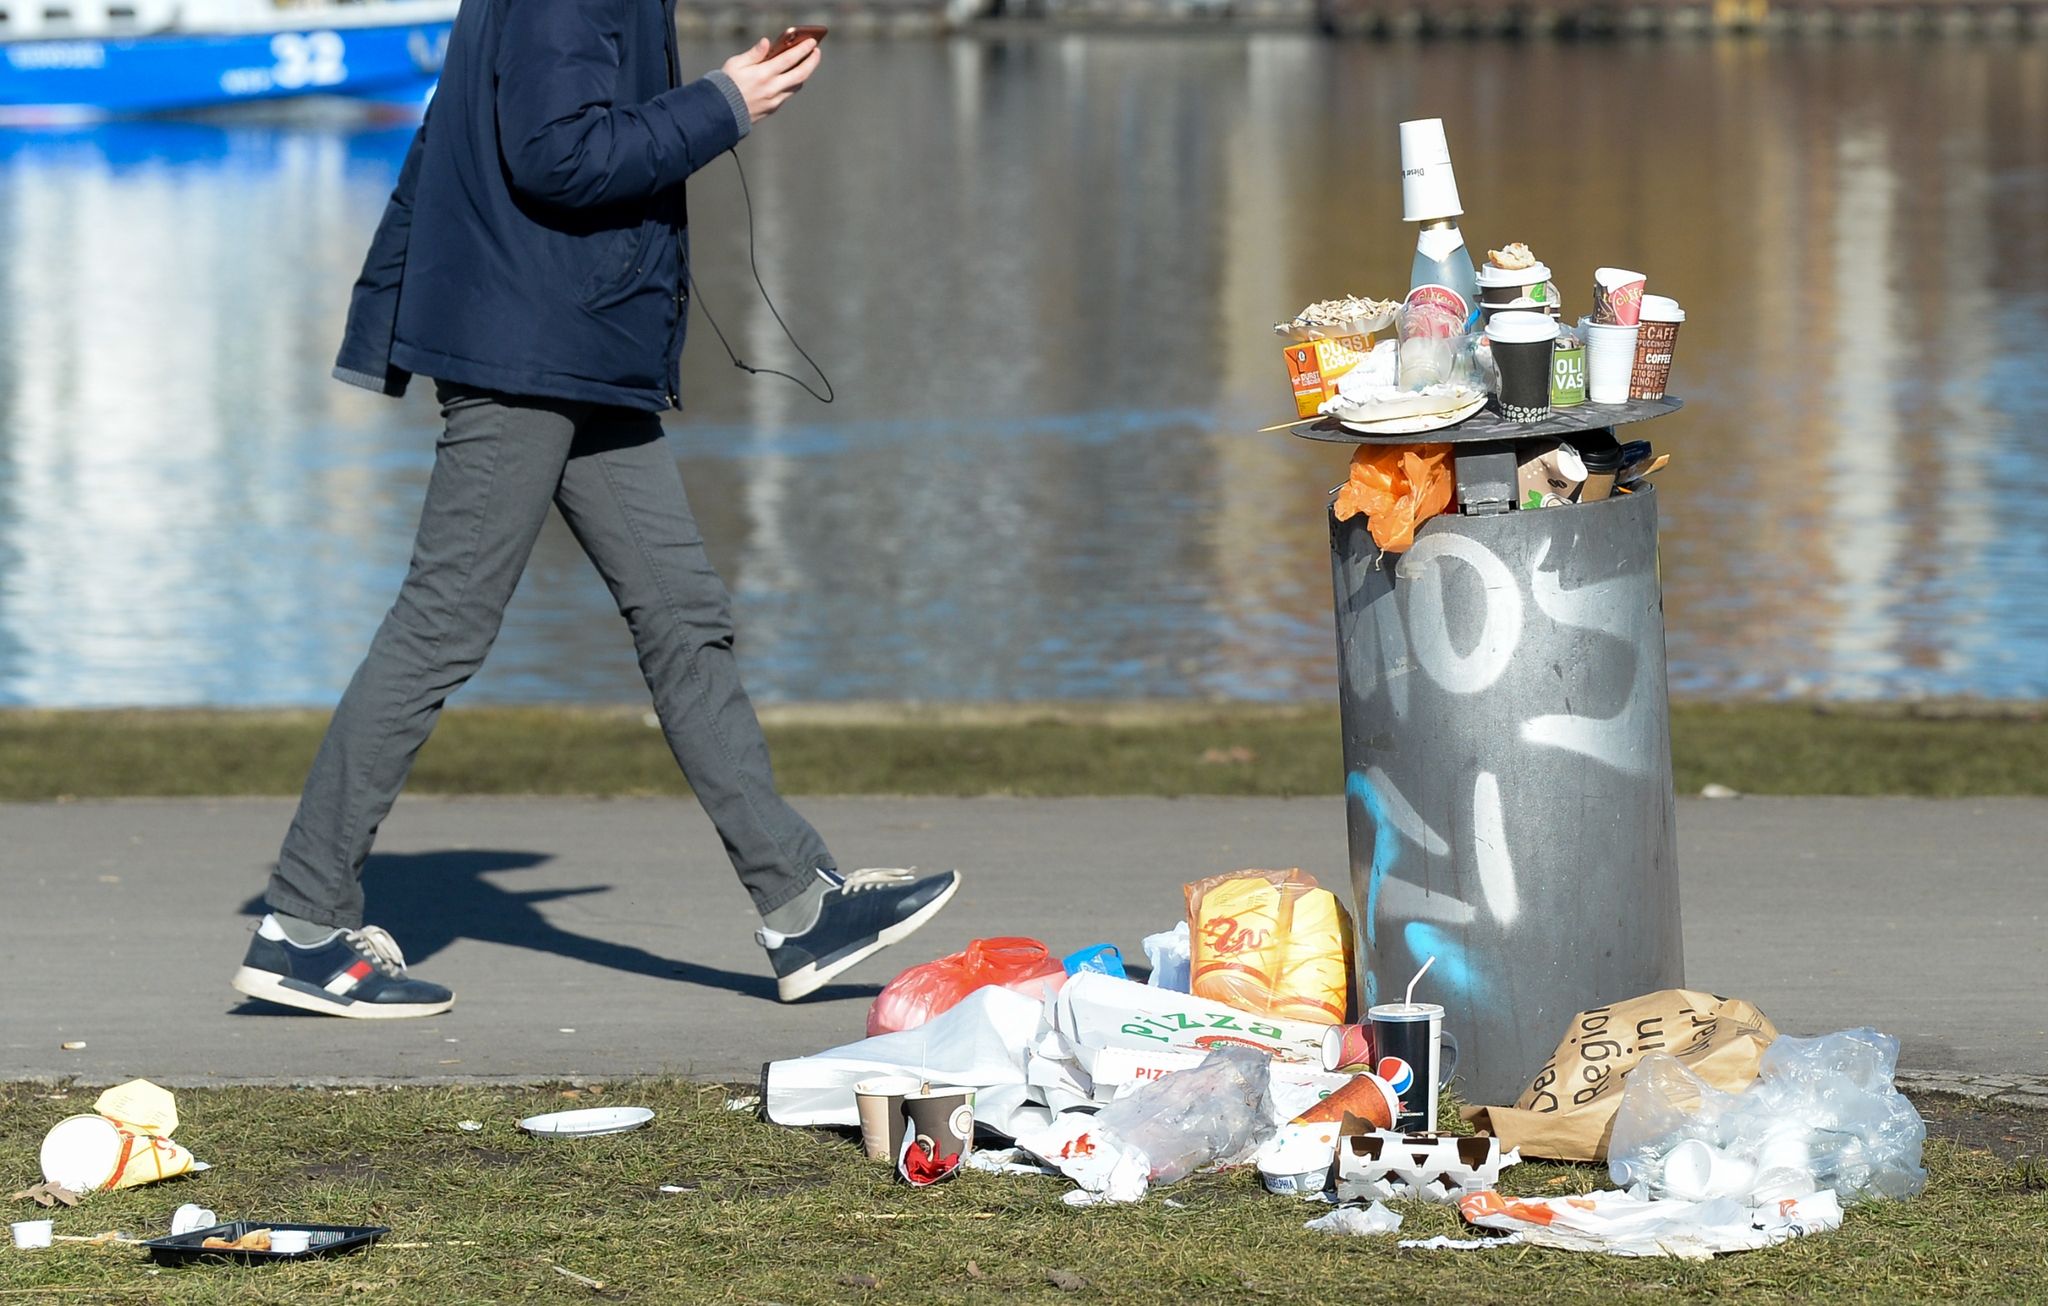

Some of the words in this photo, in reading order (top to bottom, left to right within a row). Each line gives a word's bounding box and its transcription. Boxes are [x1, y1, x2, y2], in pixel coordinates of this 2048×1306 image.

[1556, 357, 1581, 375] OLI
[1646, 353, 1671, 364] COFFEE
[1554, 373, 1584, 390] VAS
